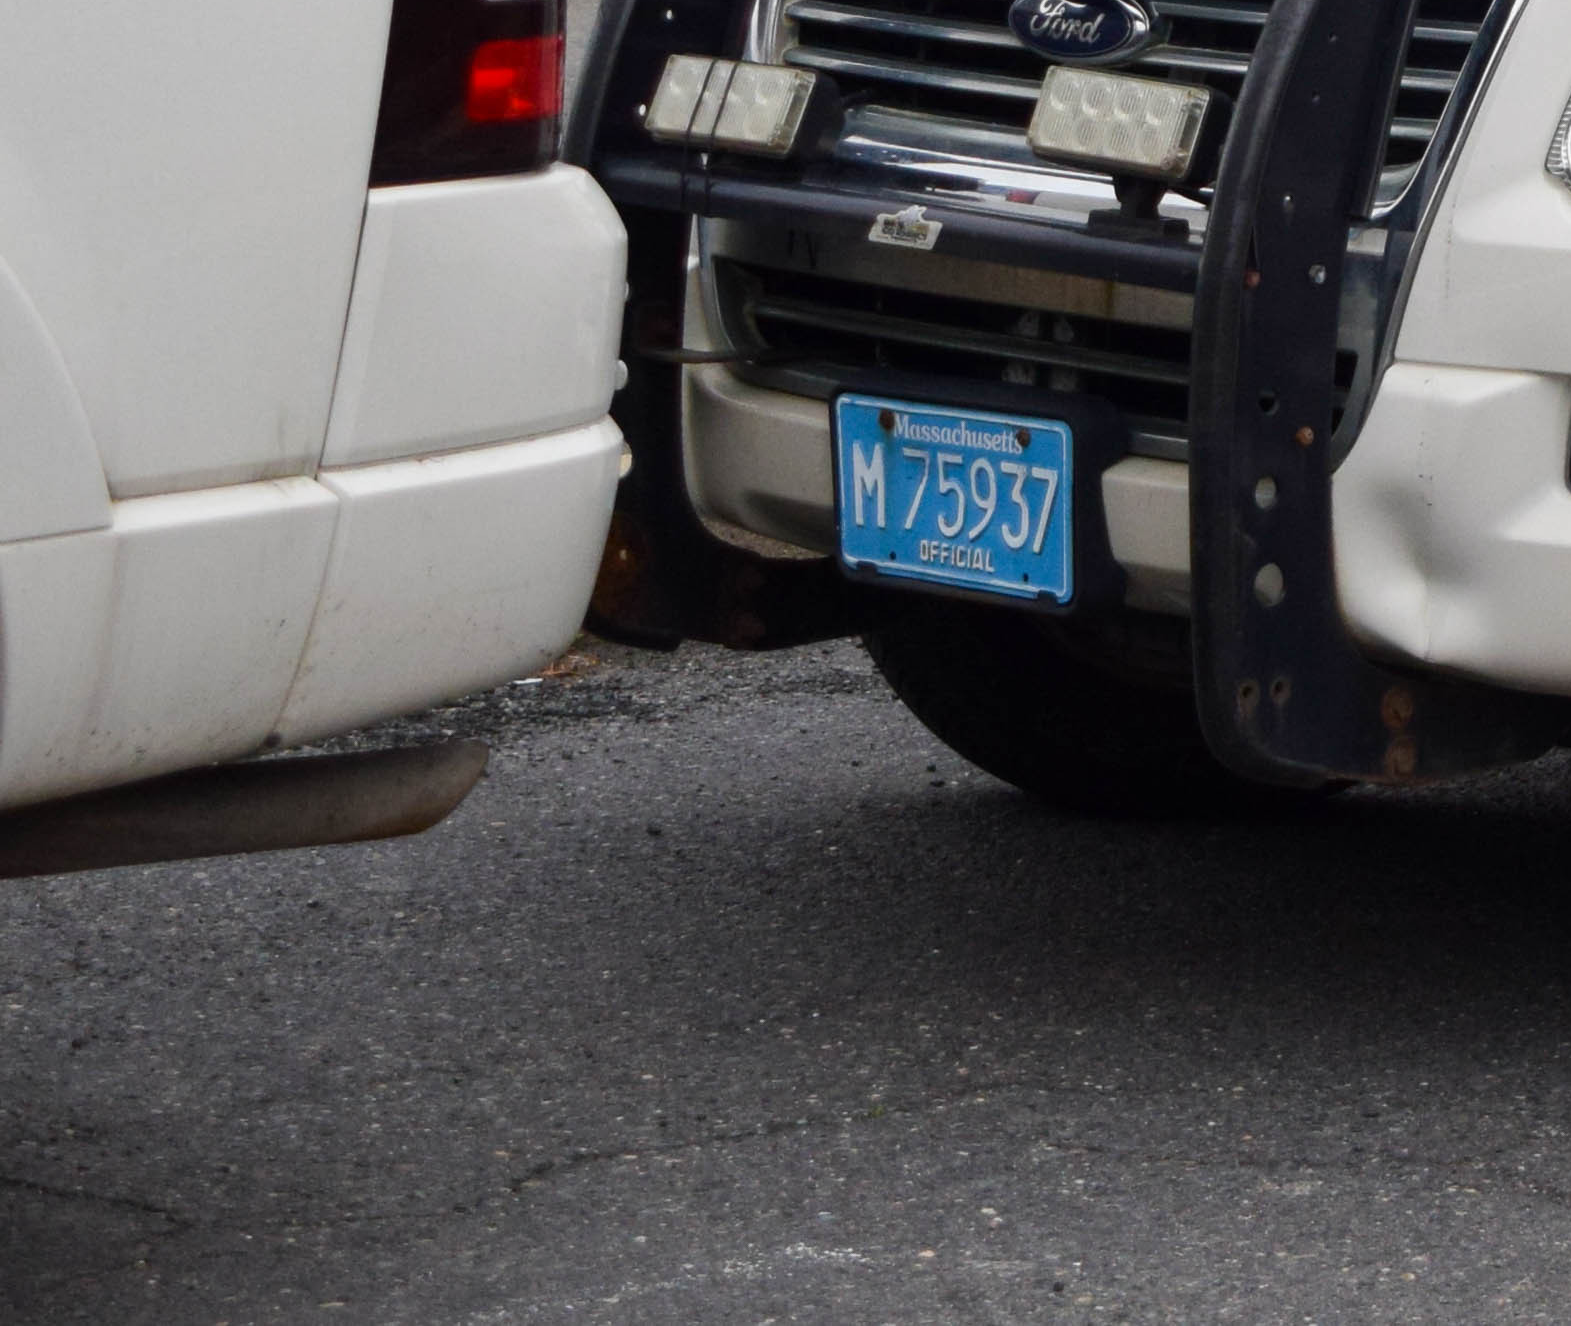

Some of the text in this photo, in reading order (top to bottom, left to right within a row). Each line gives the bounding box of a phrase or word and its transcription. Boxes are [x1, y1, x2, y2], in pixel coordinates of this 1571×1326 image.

[893, 413, 1023, 455] Massachusetts
[852, 442, 1059, 555] M 75937
[919, 539, 996, 573] OFFICIAL
